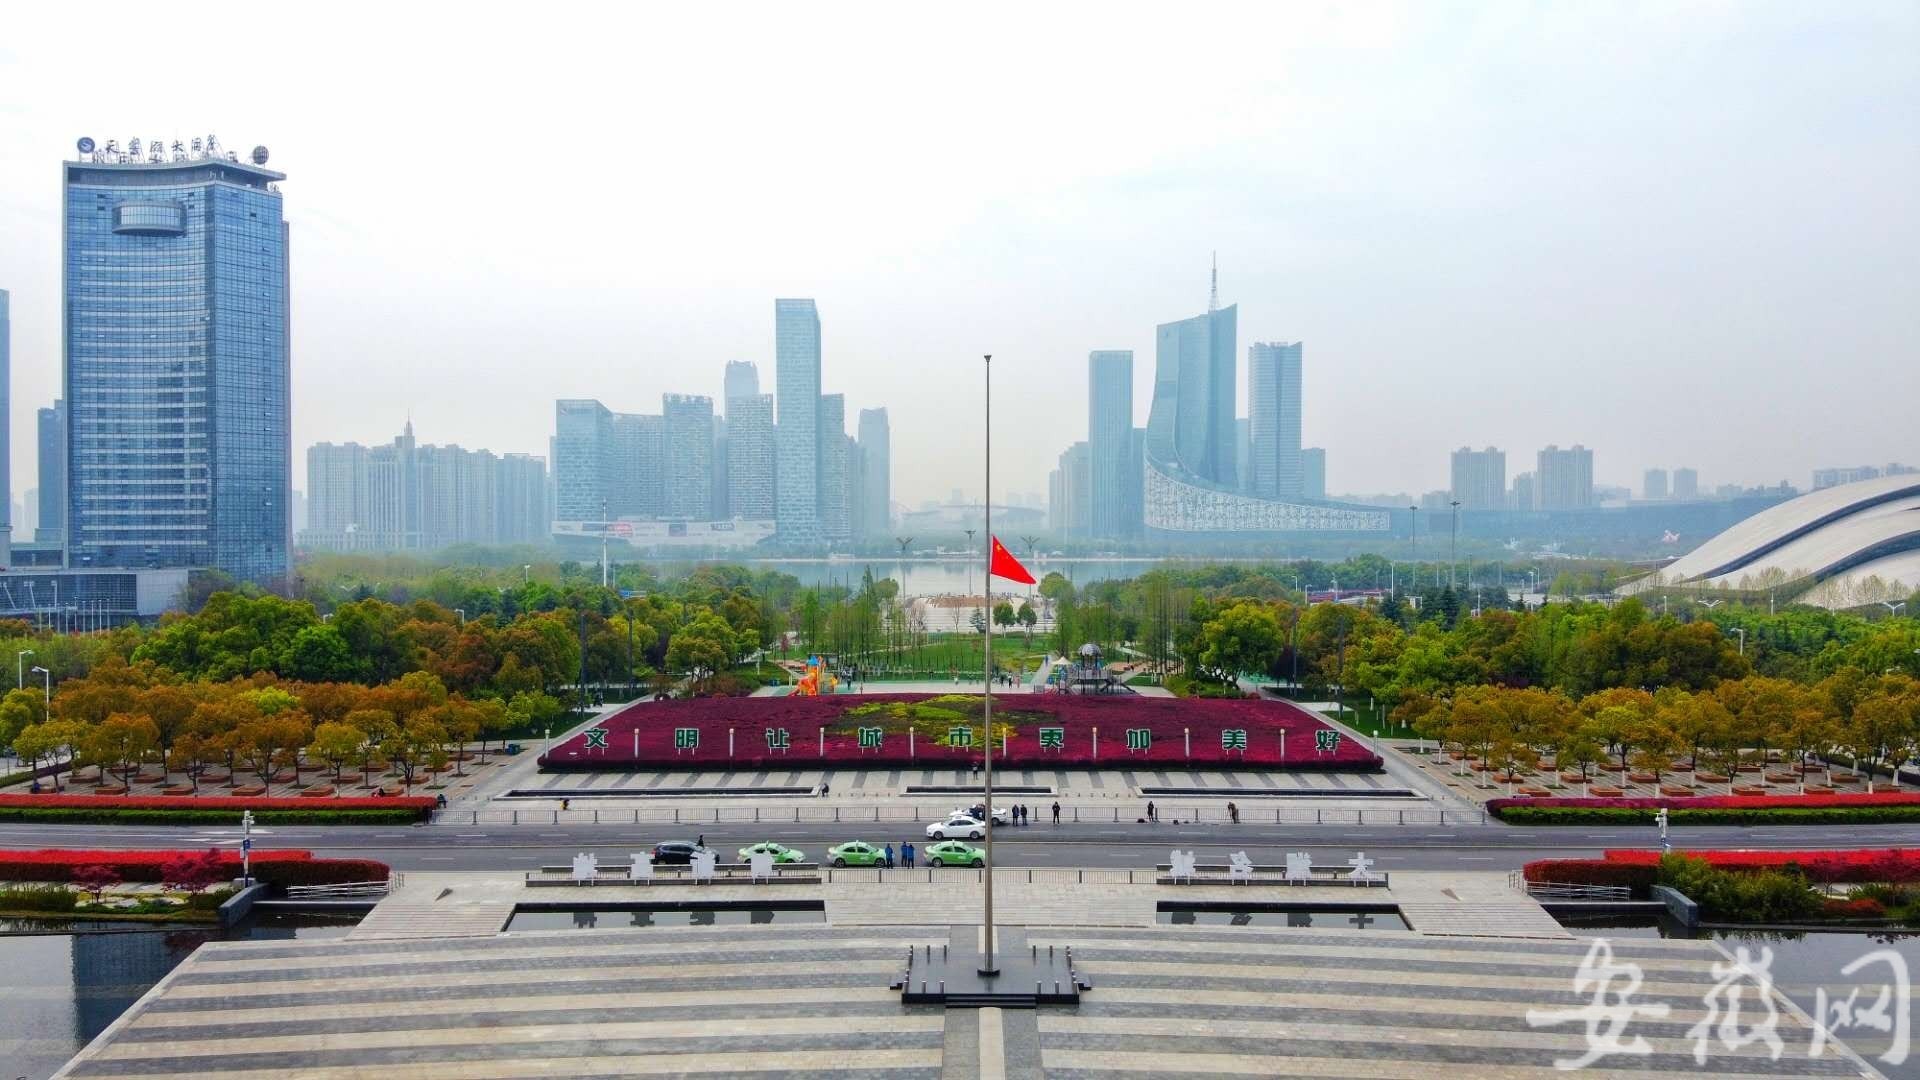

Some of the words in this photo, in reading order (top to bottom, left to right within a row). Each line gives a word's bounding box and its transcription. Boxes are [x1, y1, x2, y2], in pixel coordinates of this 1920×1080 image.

[584, 727, 1341, 751] 文明让城市更加美好
